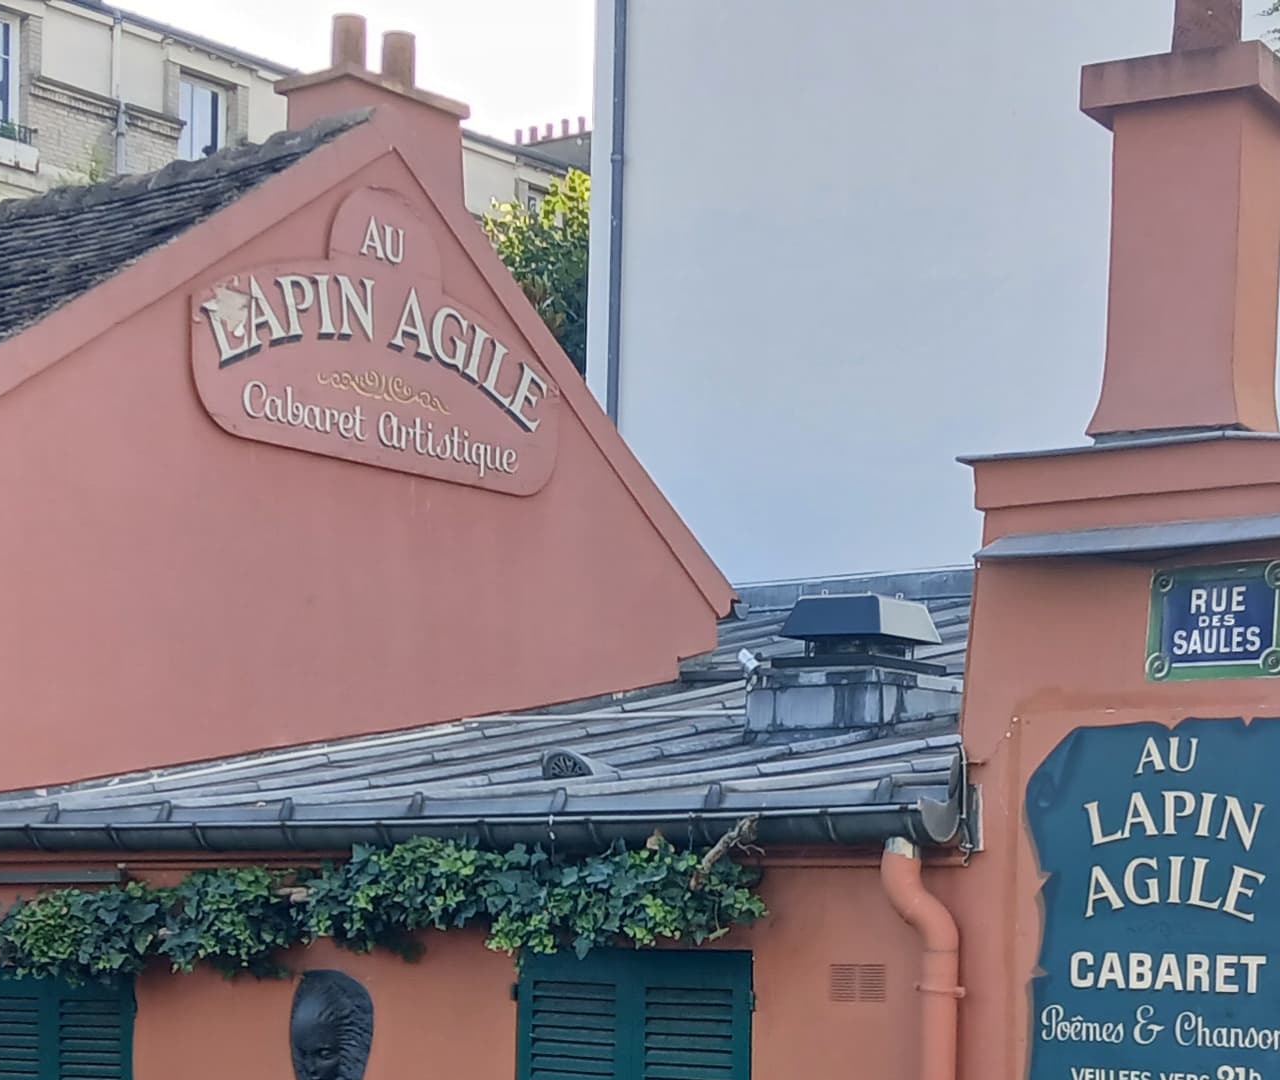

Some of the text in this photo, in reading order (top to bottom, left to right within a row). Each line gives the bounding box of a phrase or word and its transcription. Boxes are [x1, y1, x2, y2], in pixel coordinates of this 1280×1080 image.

[360, 216, 404, 264] AU
[201, 274, 548, 433] LAPIN AGILE
[242, 380, 520, 477] Cabaret Artistique
[1190, 586, 1247, 615] RUE
[1198, 614, 1236, 627] DES
[1173, 627, 1261, 655] SAULES
[1134, 735, 1199, 776] AU
[1083, 790, 1266, 852] LAPIN
[1084, 855, 1267, 922] AGILE
[1070, 951, 1267, 994] CABARET
[1040, 1004, 1124, 1043] Poêmes
[1133, 1005, 1165, 1046] &
